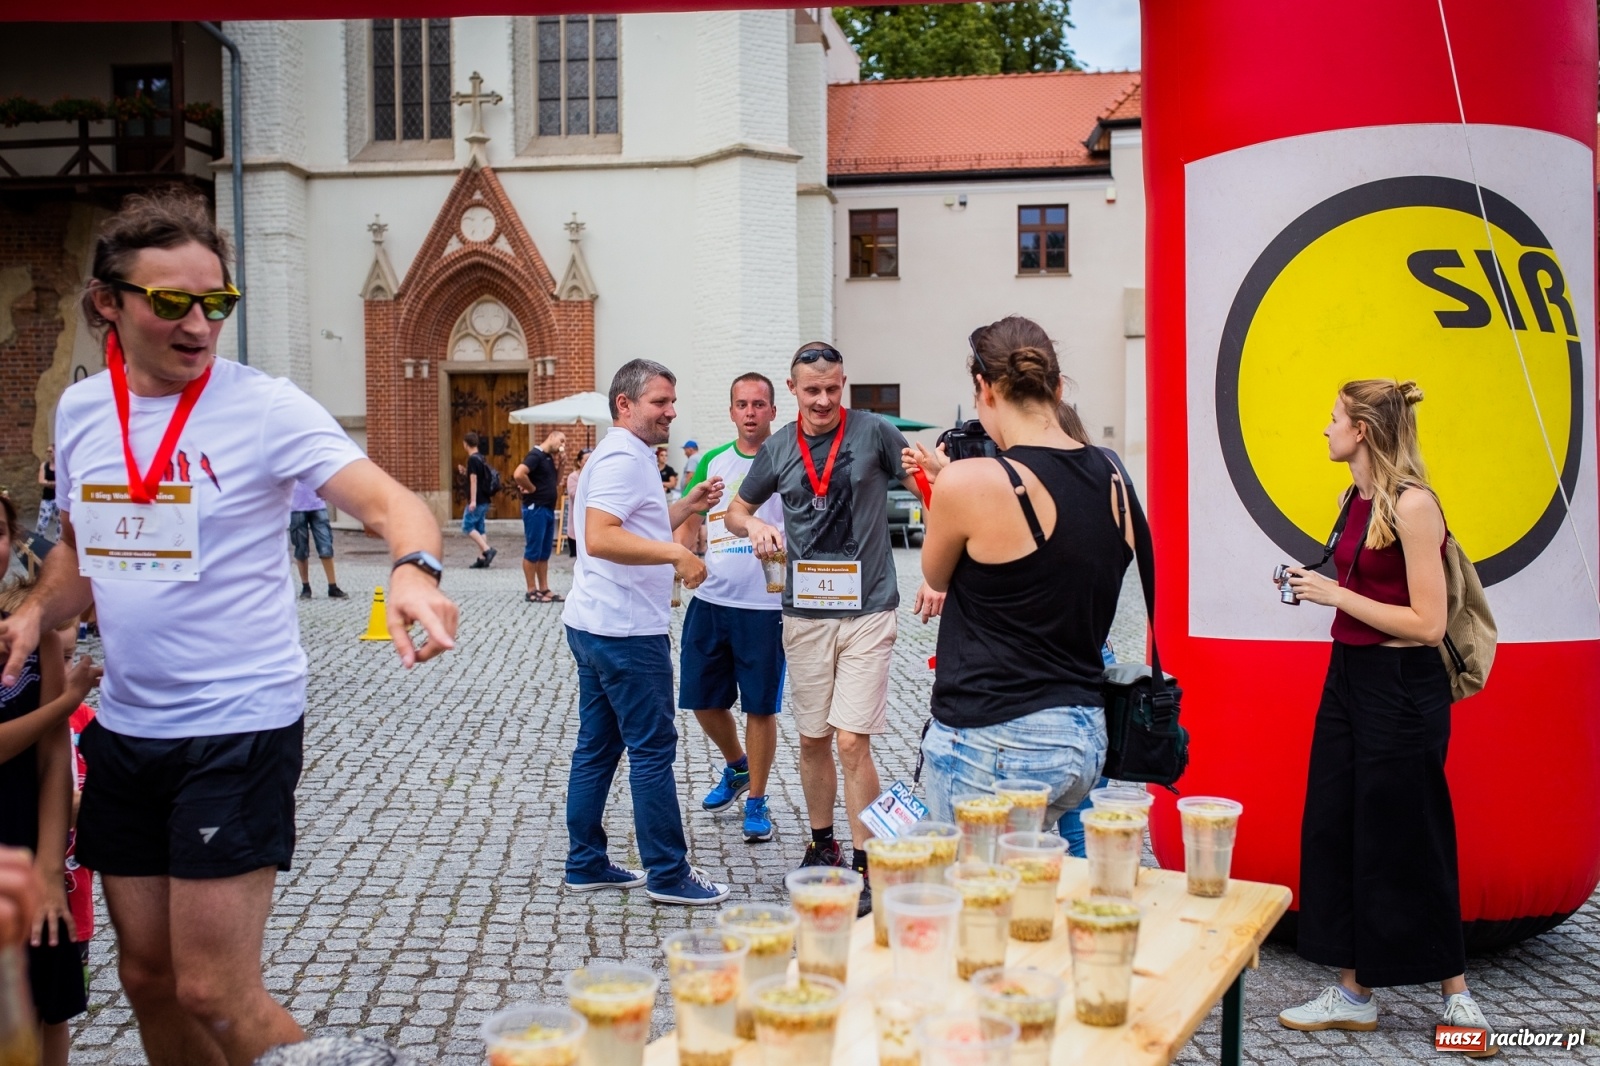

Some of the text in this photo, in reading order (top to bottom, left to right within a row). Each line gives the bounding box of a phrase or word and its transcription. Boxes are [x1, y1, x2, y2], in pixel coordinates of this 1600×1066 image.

[1407, 249, 1578, 337] SIR
[115, 516, 145, 540] 47
[818, 579, 835, 592] 41
[891, 782, 925, 818] PRASA
